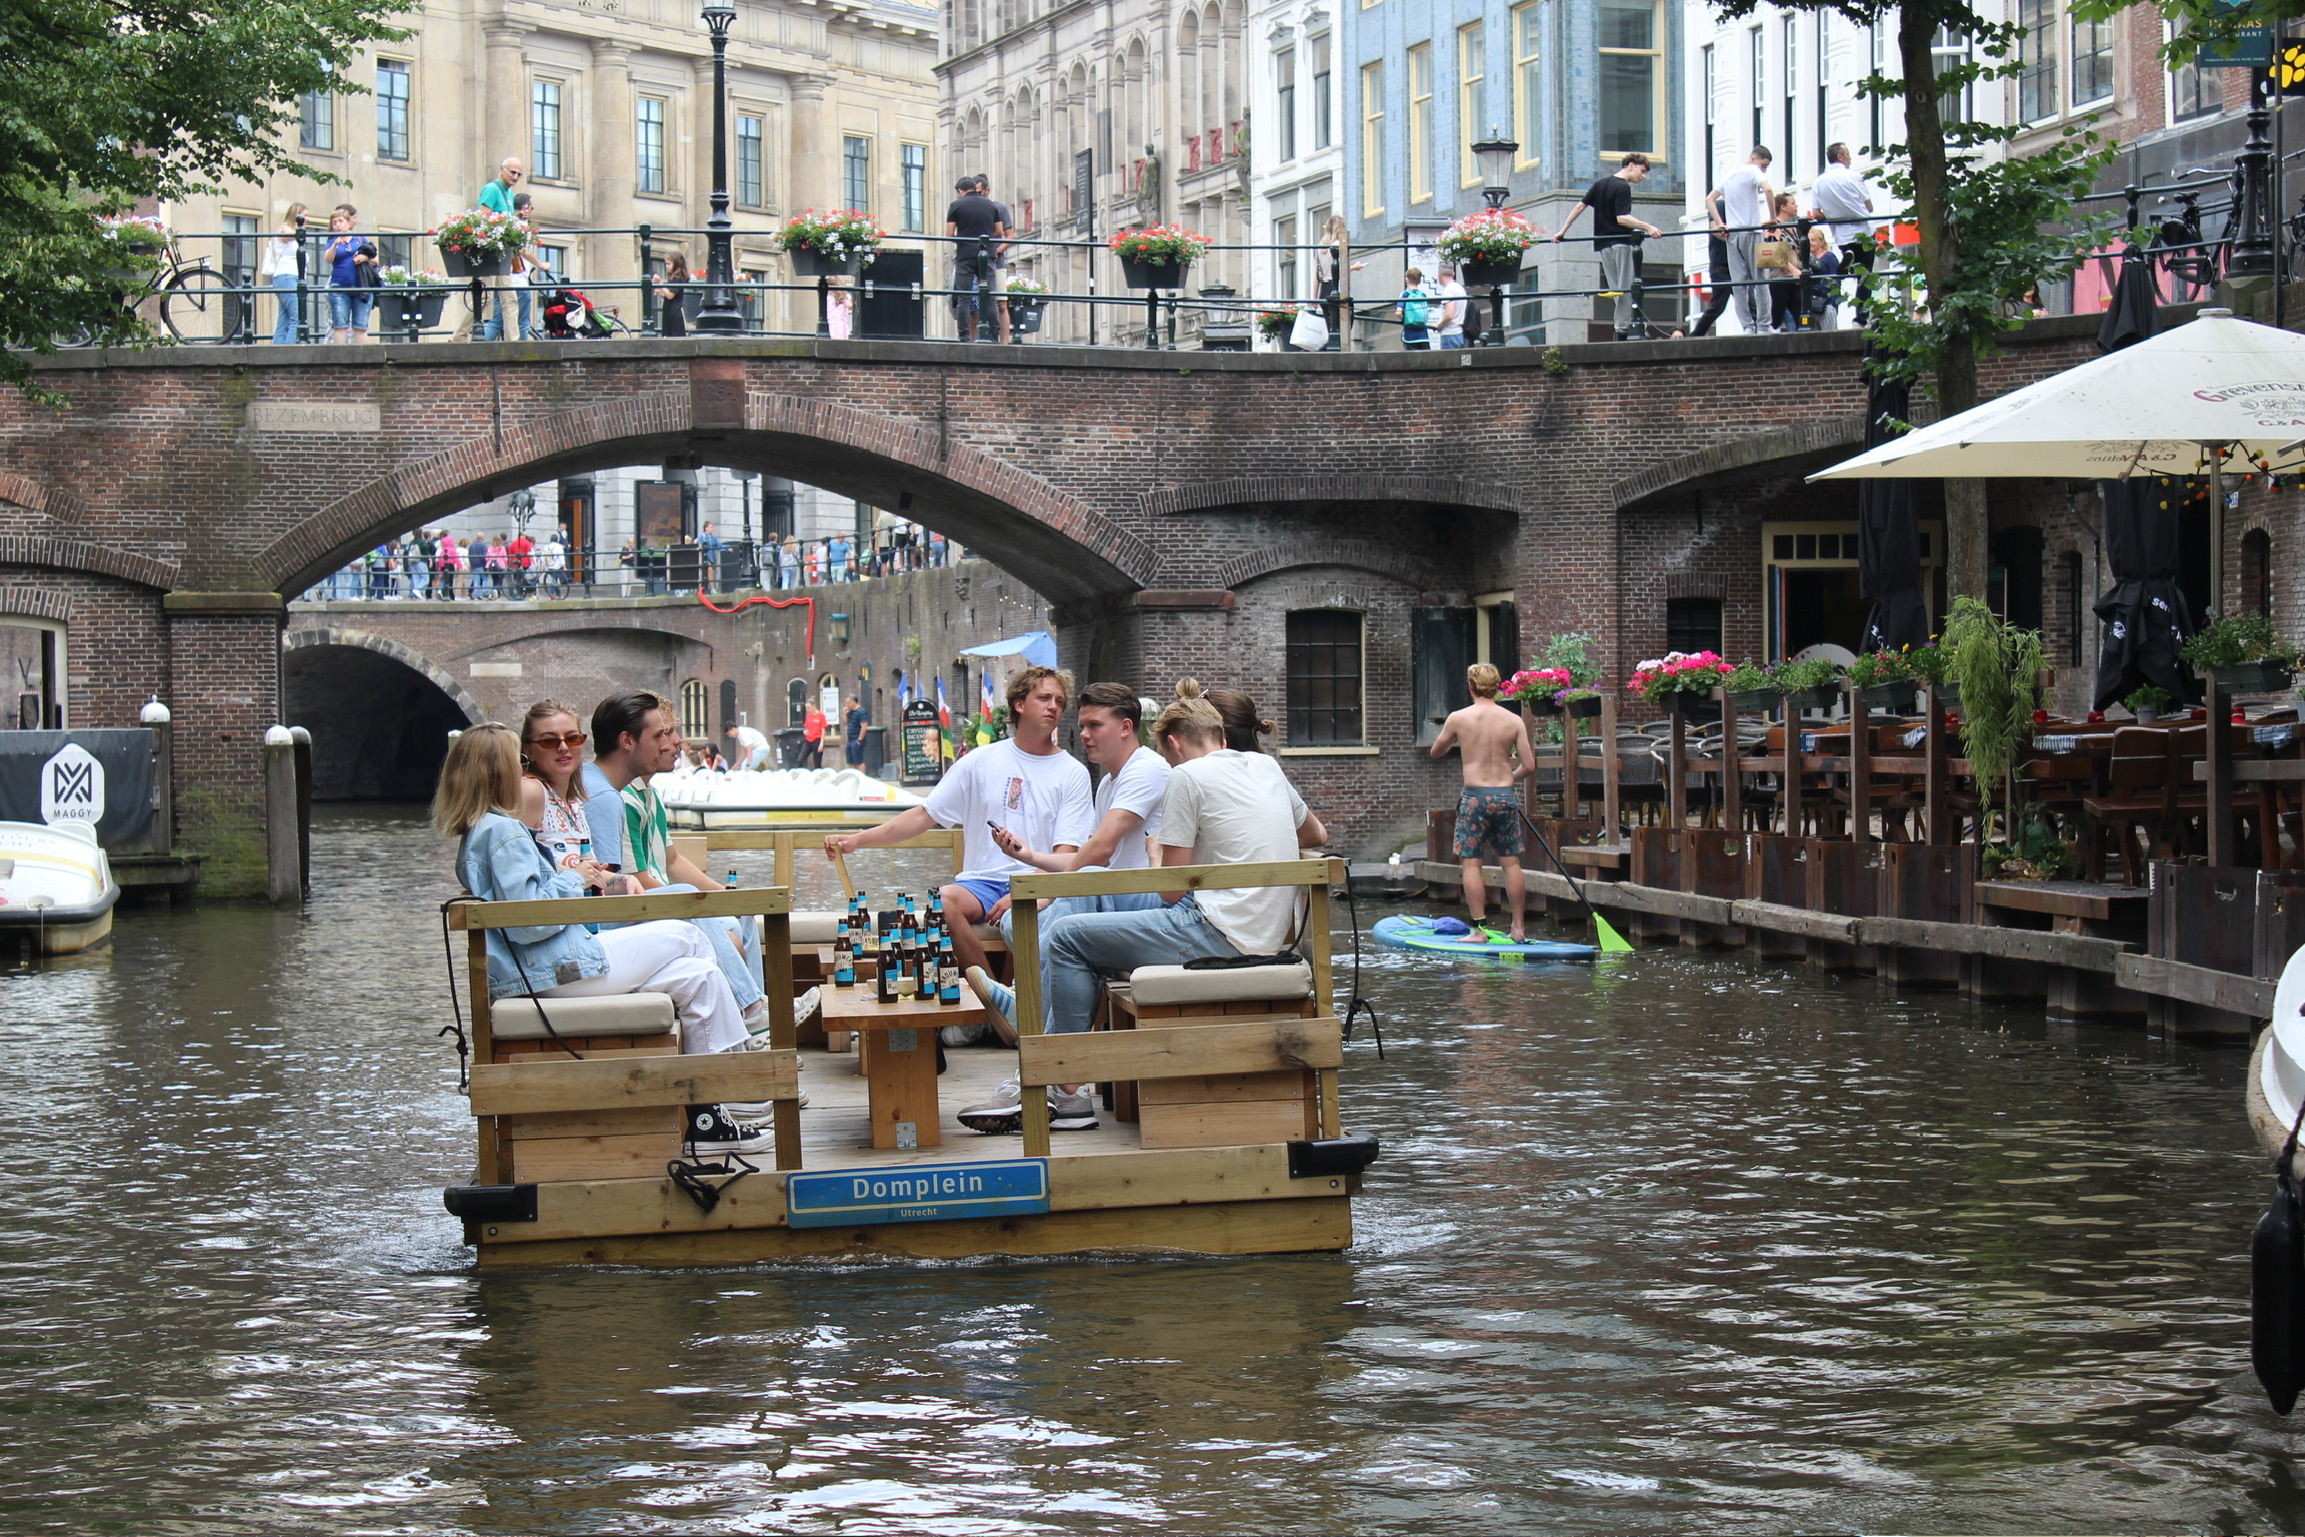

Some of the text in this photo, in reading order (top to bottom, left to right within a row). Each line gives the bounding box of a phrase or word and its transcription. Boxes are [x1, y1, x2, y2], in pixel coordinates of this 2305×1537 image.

[252, 407, 373, 425] BEZEMBRUG
[53, 808, 92, 819] MAGGY
[853, 1171, 983, 1201] Domplein
[900, 1207, 938, 1218] Utrecht
